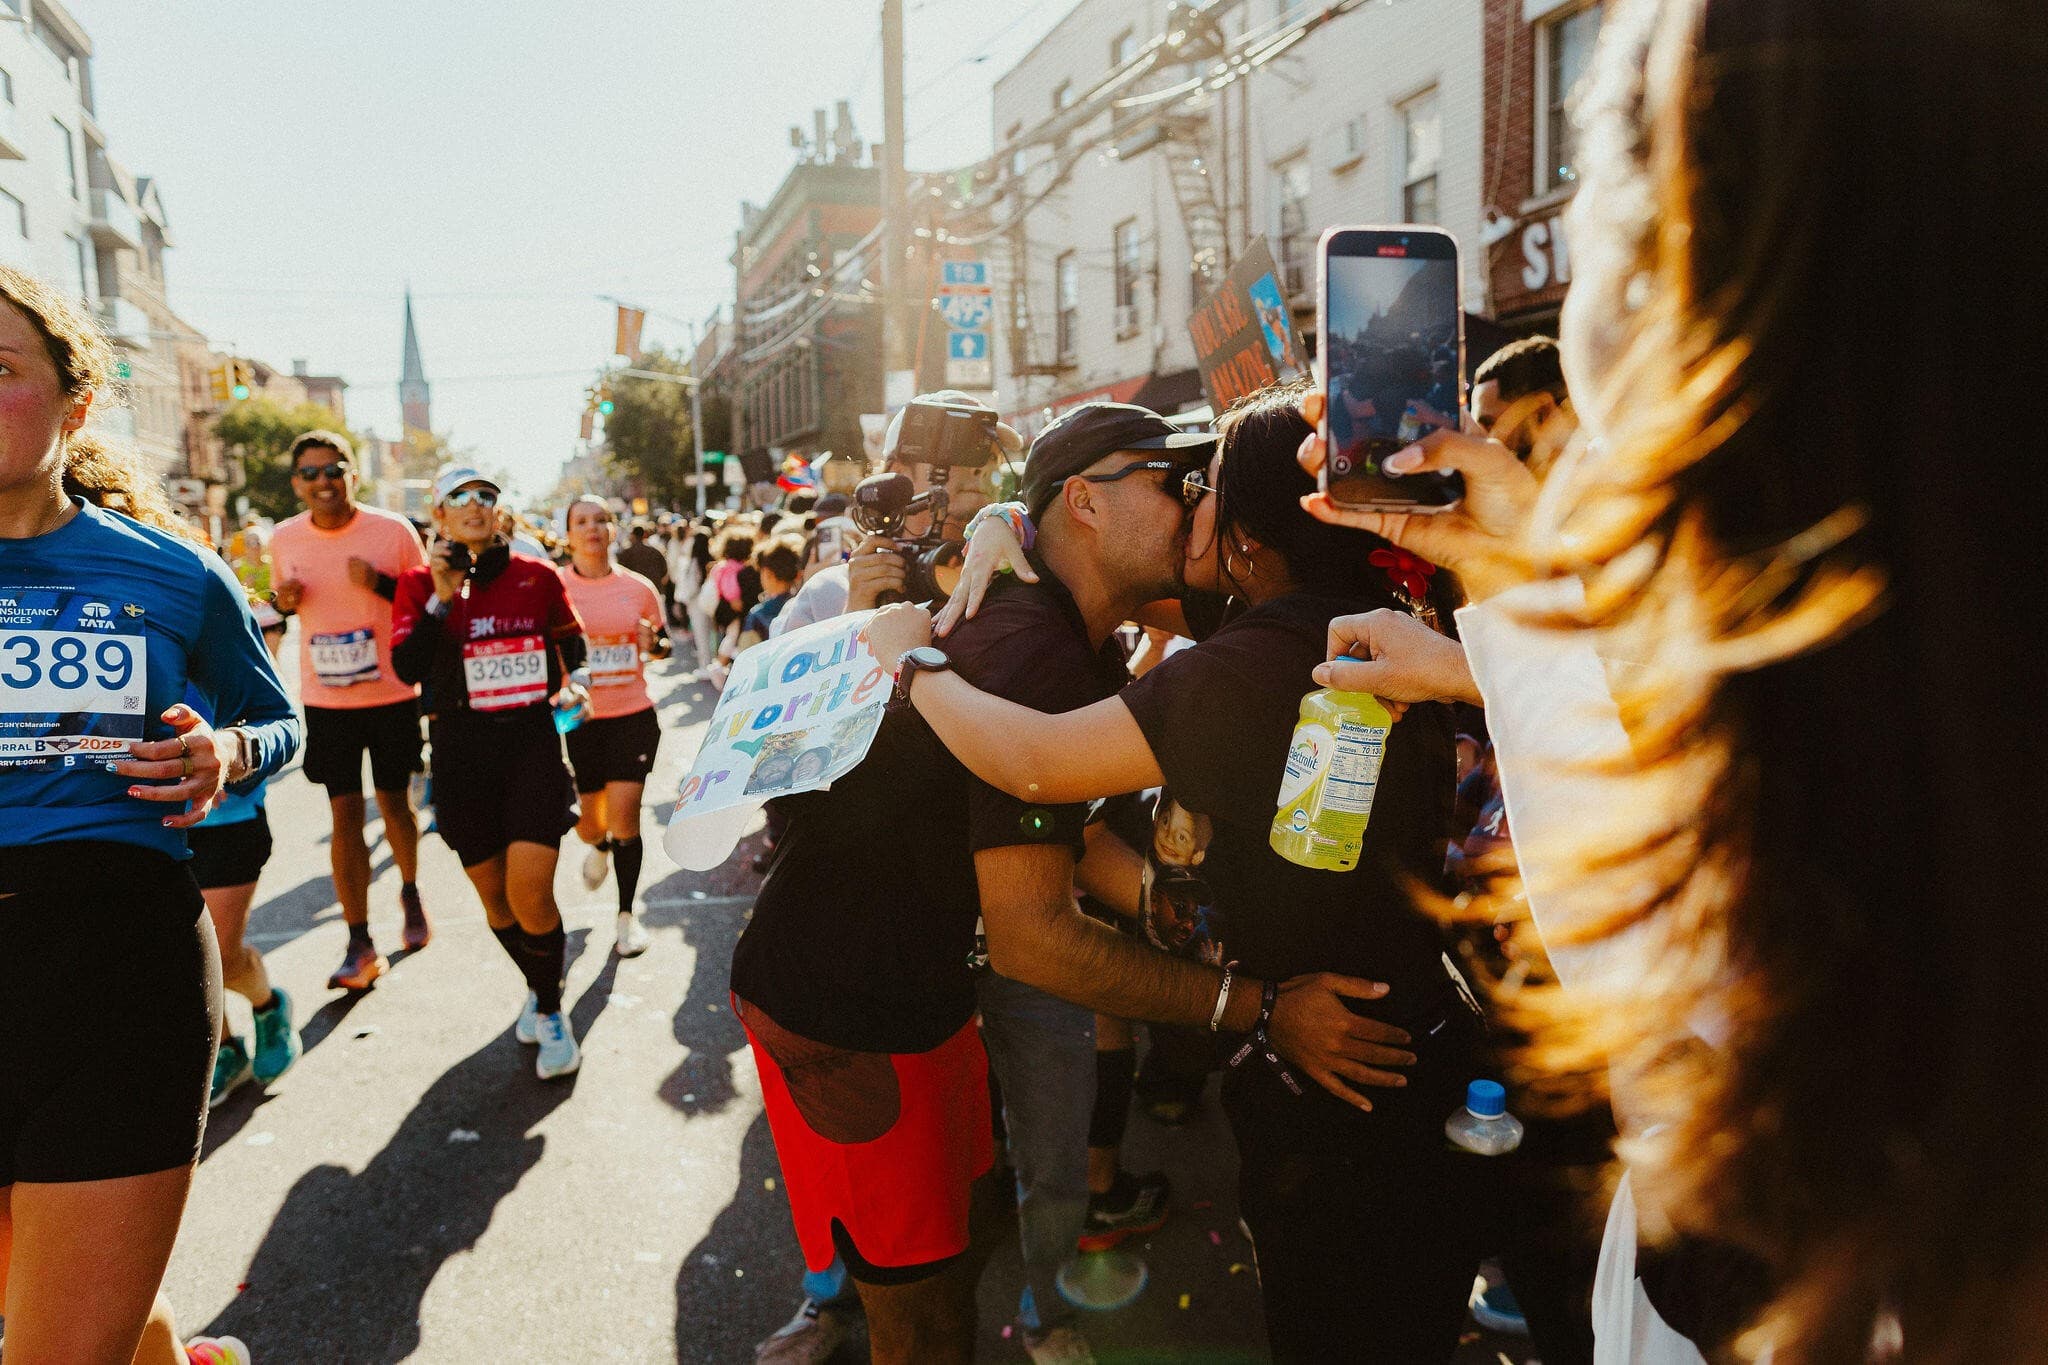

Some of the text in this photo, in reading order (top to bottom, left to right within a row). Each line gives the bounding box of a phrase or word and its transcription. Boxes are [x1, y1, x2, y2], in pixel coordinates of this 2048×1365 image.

[0, 599, 18, 608] TA
[78, 618, 116, 630] TATA
[1, 635, 133, 691] 389
[471, 654, 540, 681] 32659
[1340, 723, 1369, 734] Nutrition
[0, 740, 46, 752] RRAL B
[80, 738, 122, 750] 2025
[1362, 746, 1371, 754] 70
[64, 756, 76, 767] B
